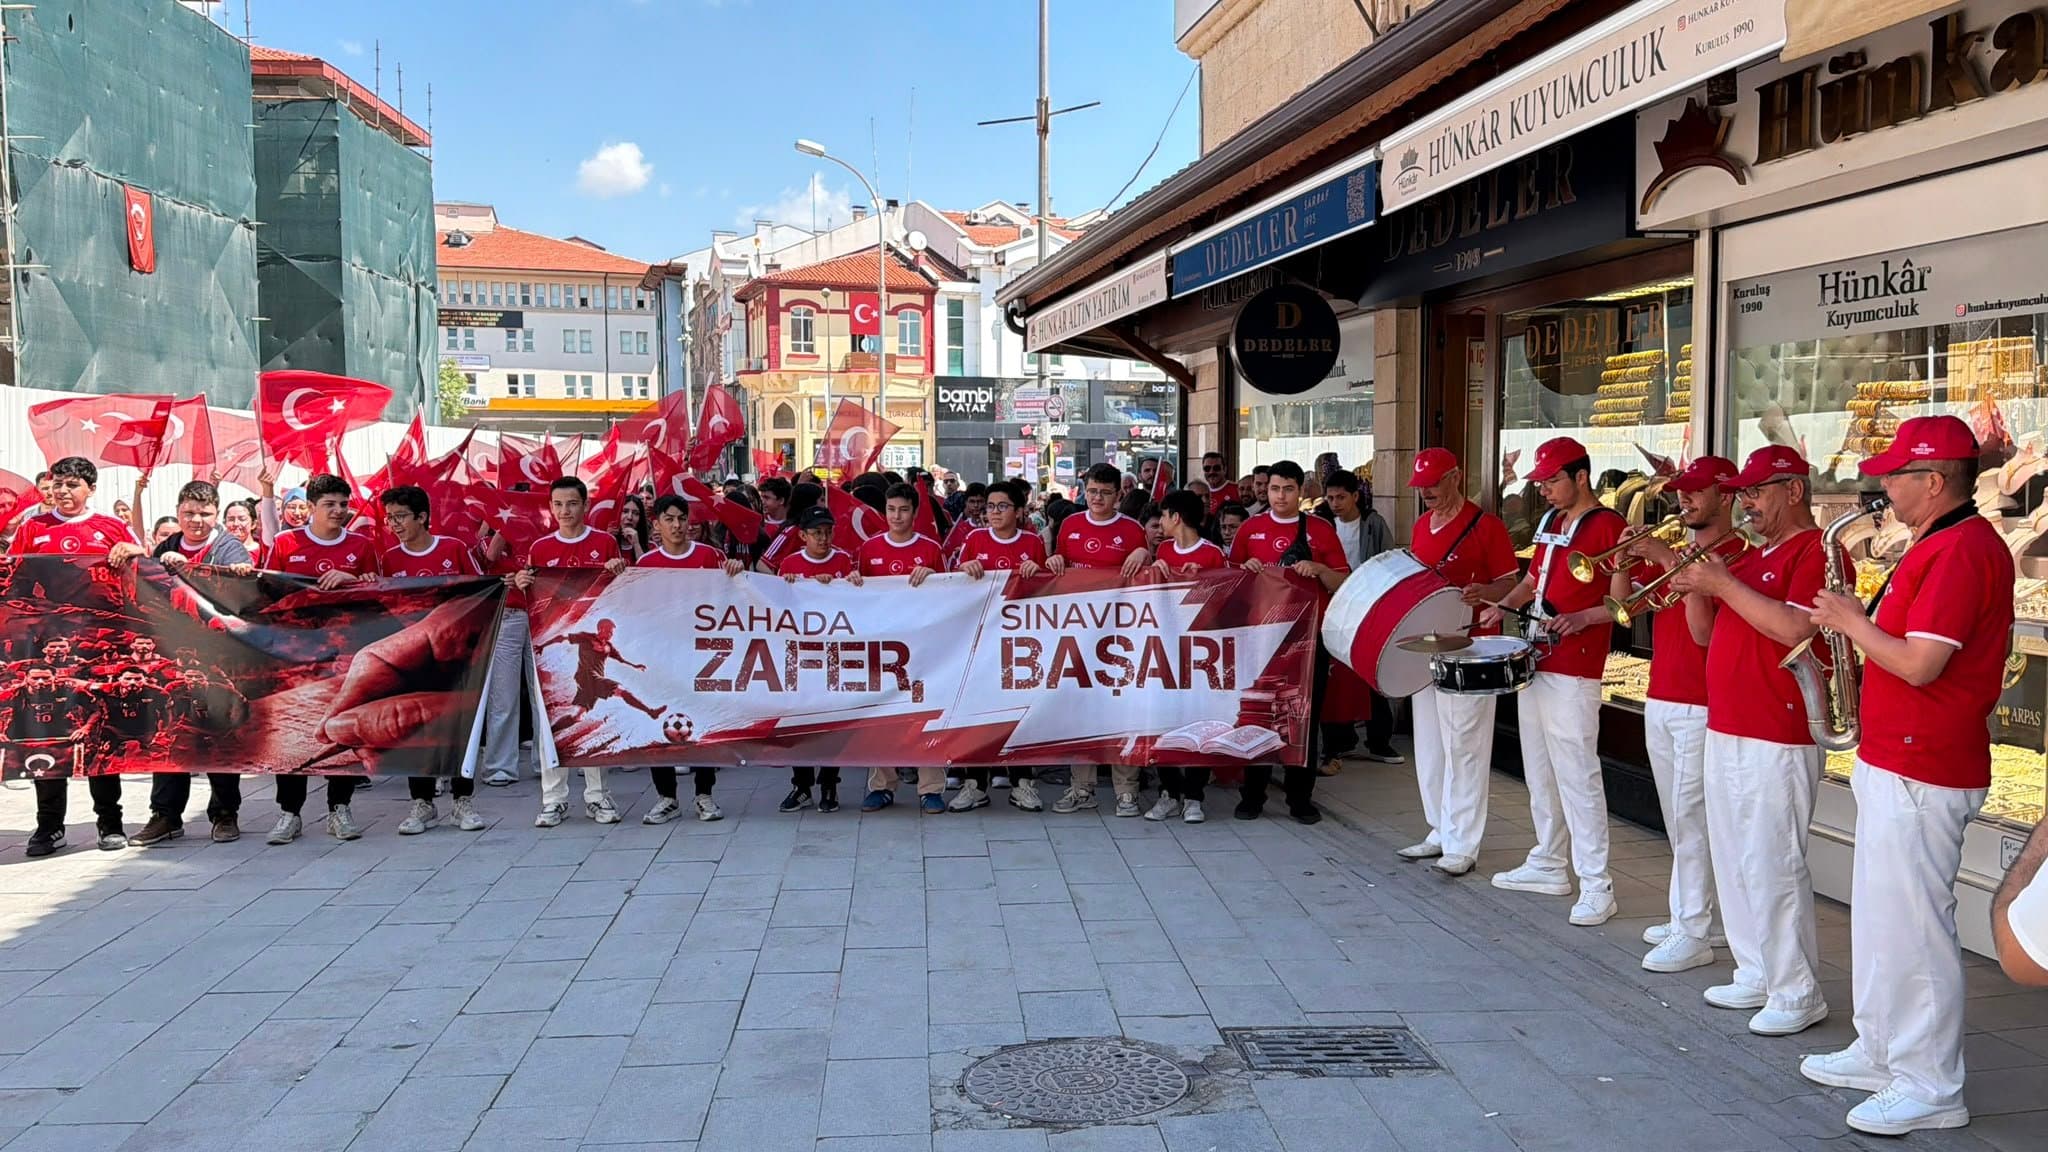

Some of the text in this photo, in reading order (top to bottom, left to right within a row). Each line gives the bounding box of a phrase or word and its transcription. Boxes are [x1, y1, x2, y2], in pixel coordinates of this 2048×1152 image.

[1733, 18, 1754, 39] 1990
[1429, 26, 1667, 177] HÜNKÂR KUYUMCULUK
[1206, 206, 1298, 277] DEDELER
[1733, 283, 1770, 300] Kuruluş
[1817, 258, 1931, 307] Hünkâr
[1068, 298, 1091, 329] ALTIN
[1091, 280, 1130, 321] YATIRIM
[1276, 302, 1302, 328] D
[1740, 301, 1762, 313] 1990
[1826, 298, 1919, 329] Kuyumculuk
[1526, 301, 1664, 360] DEDELER
[1243, 339, 1332, 352] DEDELER
[938, 386, 993, 403] bambi
[949, 403, 986, 413] YATAK
[1033, 424, 1071, 437] aelik
[1141, 425, 1176, 438] arçeik
[88, 567, 110, 583] 18
[694, 604, 855, 636] SAHADA
[1001, 602, 1159, 631] SINAVDA
[694, 637, 924, 703] ZAFER,
[1001, 635, 1236, 696] BAŞARI
[35, 713, 52, 723] 10
[2011, 707, 2041, 727] ARPAS
